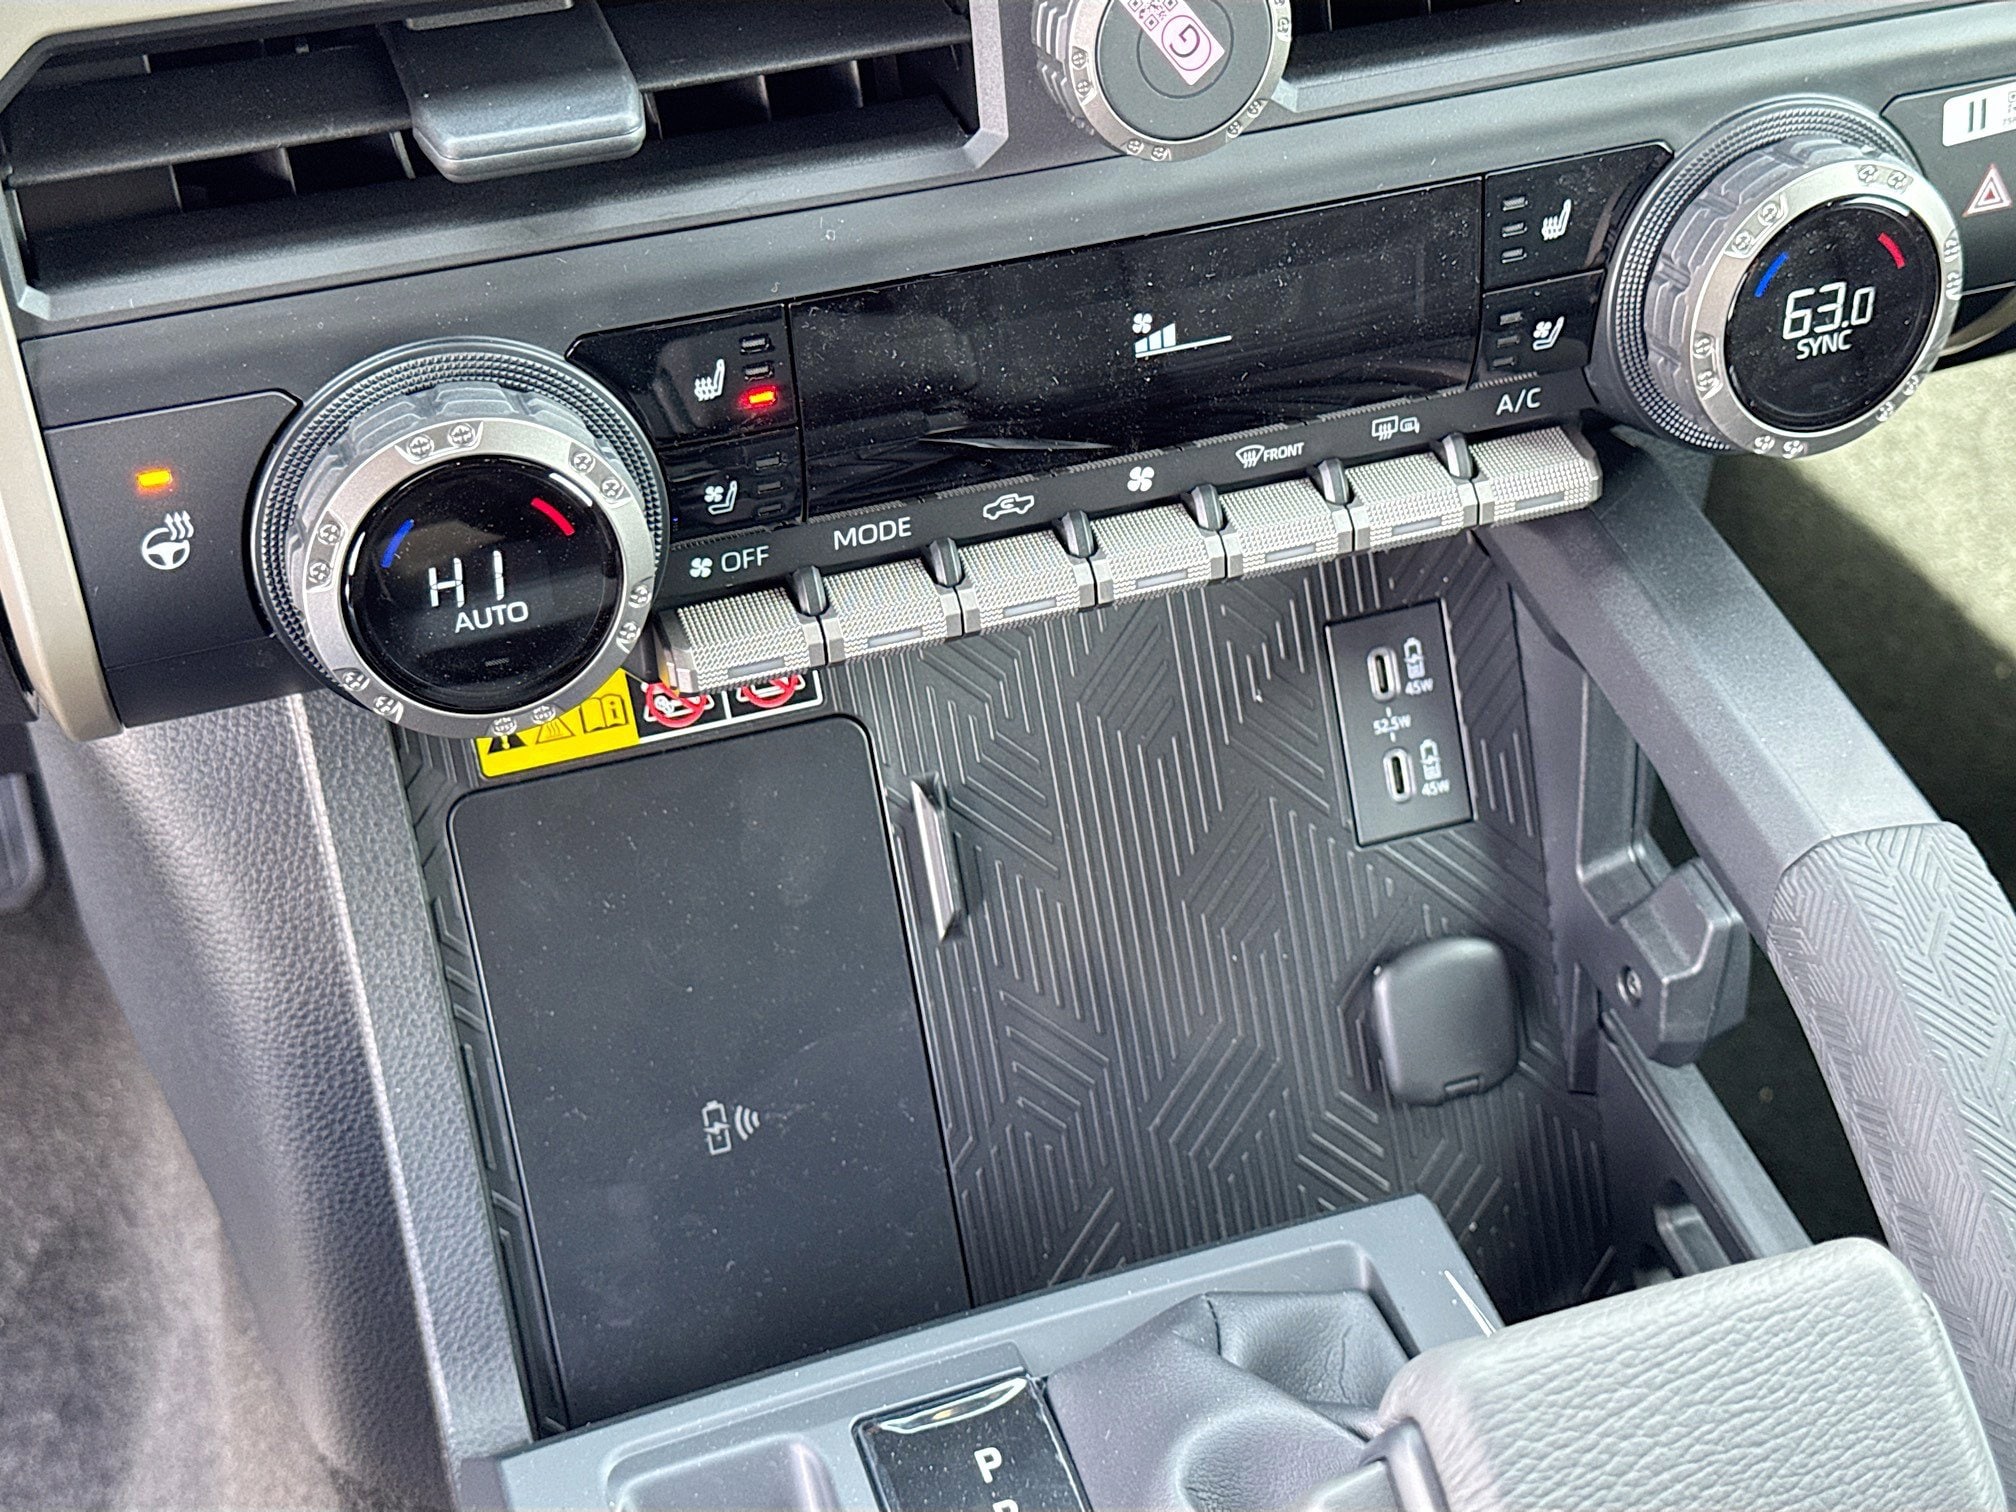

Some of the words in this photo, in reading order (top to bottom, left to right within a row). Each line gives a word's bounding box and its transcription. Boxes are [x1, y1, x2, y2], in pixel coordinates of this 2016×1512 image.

[1783, 281, 1876, 340] 63.0
[1796, 329, 1853, 360] SYNC
[1496, 387, 1541, 415] A/C
[1262, 441, 1304, 463] FRONT
[833, 516, 912, 551] MODE
[720, 545, 769, 573] OFF
[455, 601, 529, 634] AUTO
[1405, 678, 1434, 696] 45W
[1421, 779, 1450, 796] 45W
[974, 1447, 1002, 1484] P
